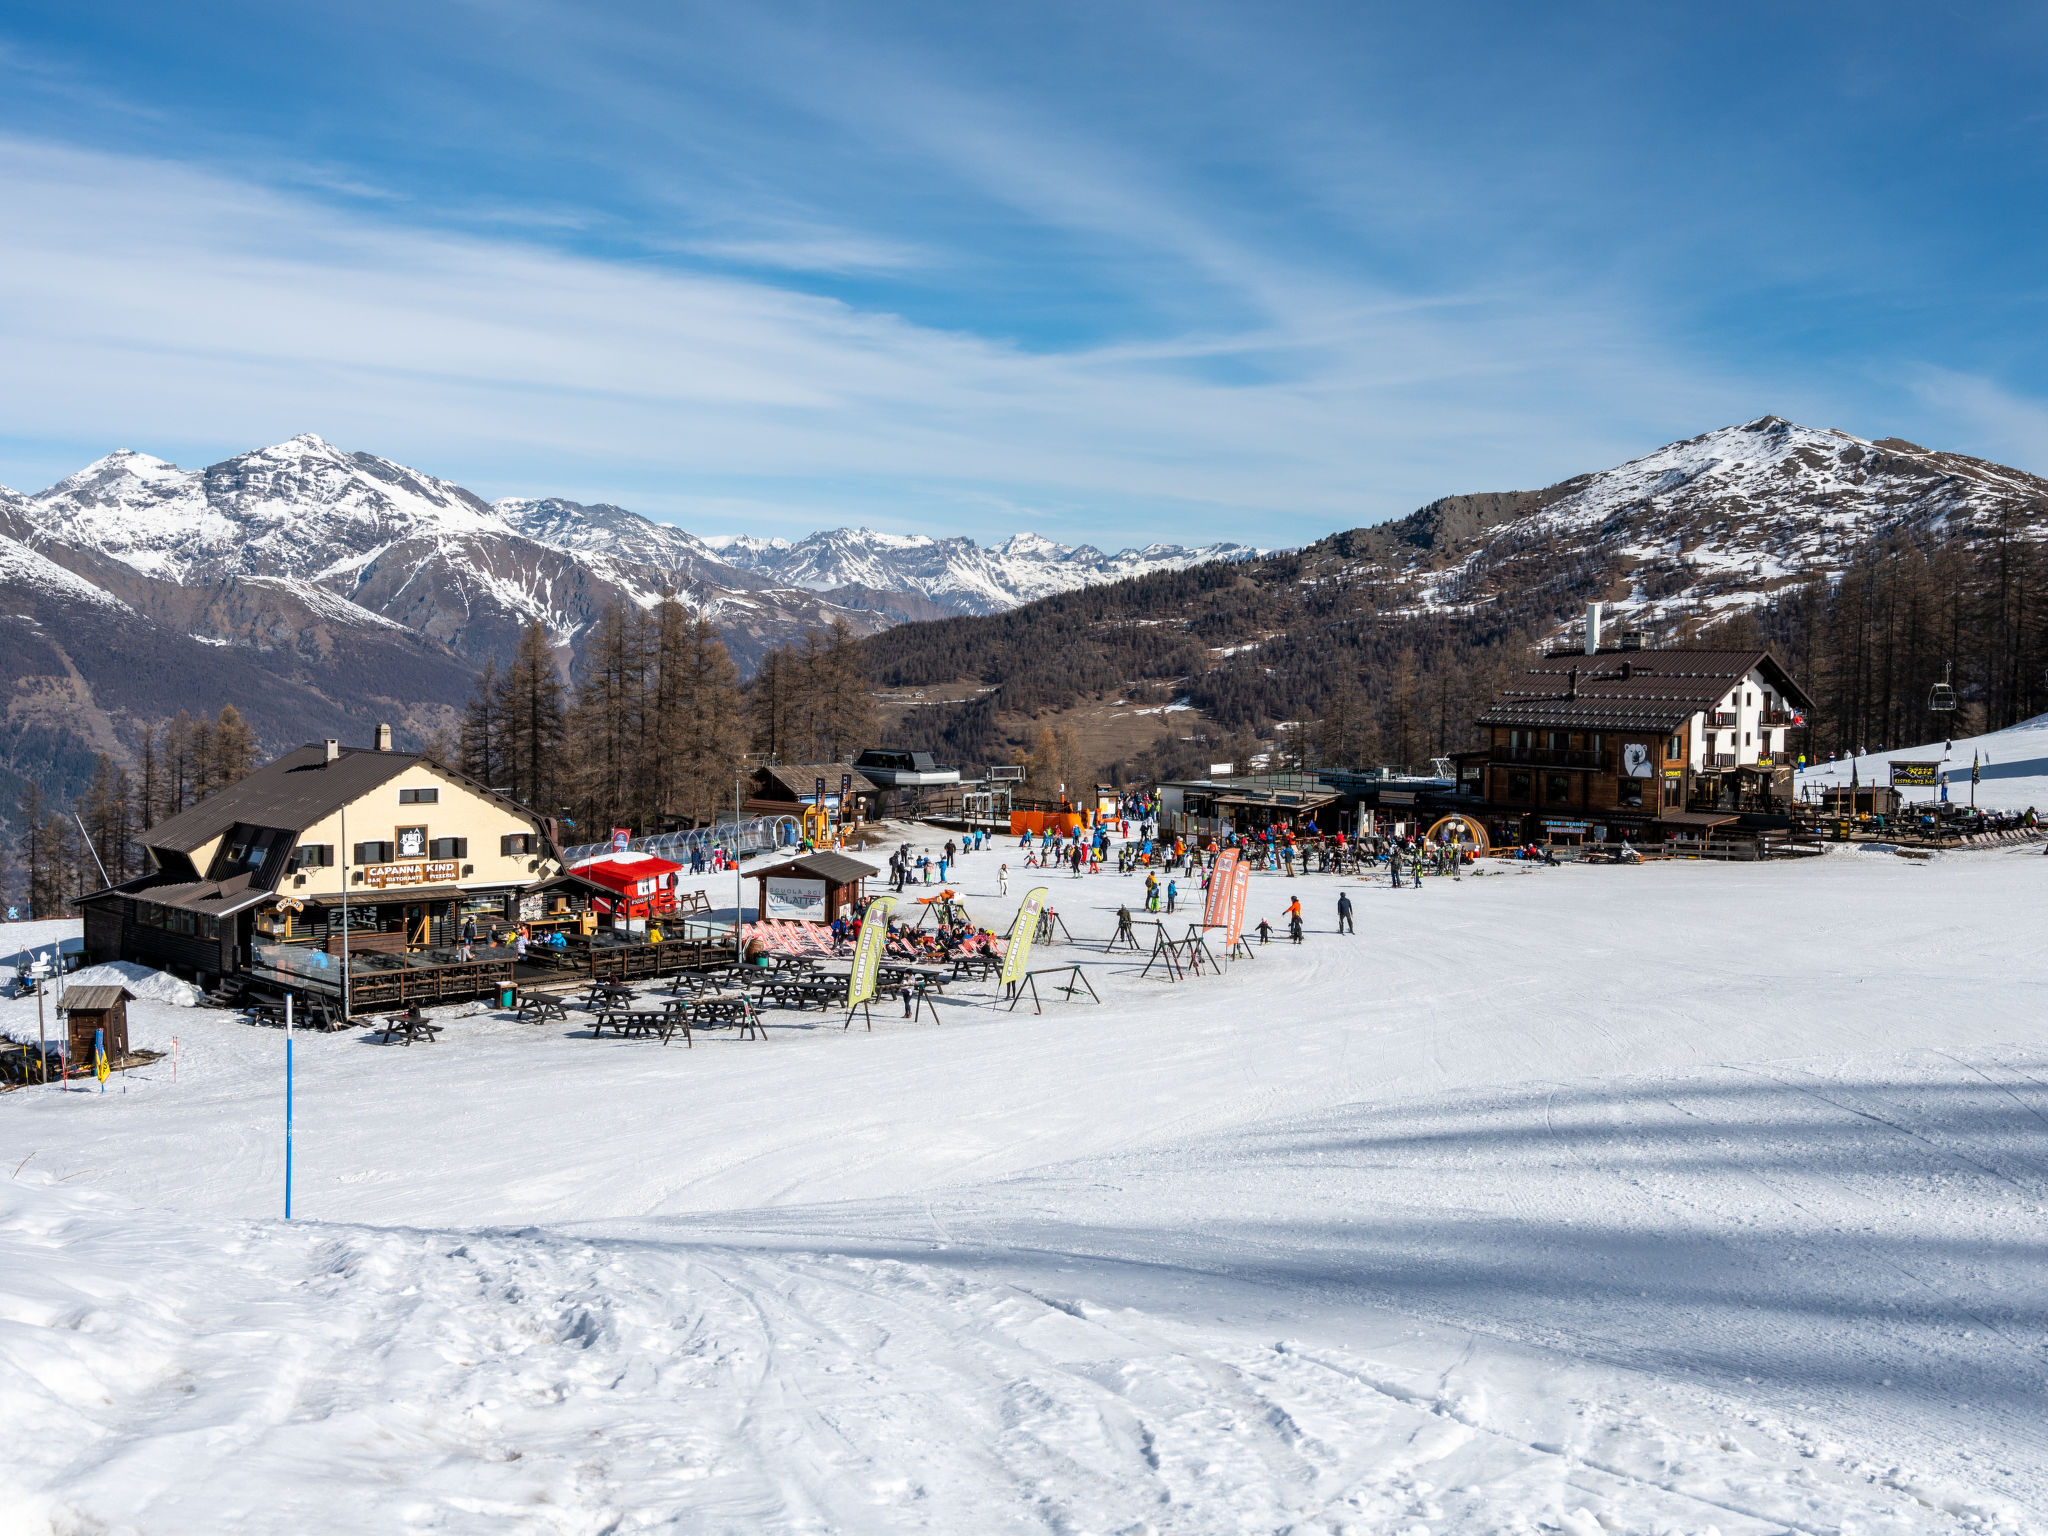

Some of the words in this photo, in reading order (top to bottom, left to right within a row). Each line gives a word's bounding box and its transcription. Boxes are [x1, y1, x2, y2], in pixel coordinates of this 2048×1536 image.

[369, 865, 422, 876] CAPANNA
[426, 863, 455, 872] KIND
[1213, 872, 1222, 890] KIND
[1228, 904, 1237, 940] CAPANNA
[854, 951, 868, 997] CAPANNA
[861, 926, 873, 951] KIND
[1006, 936, 1021, 977] CAPANNA
[1017, 913, 1027, 936] KIND
